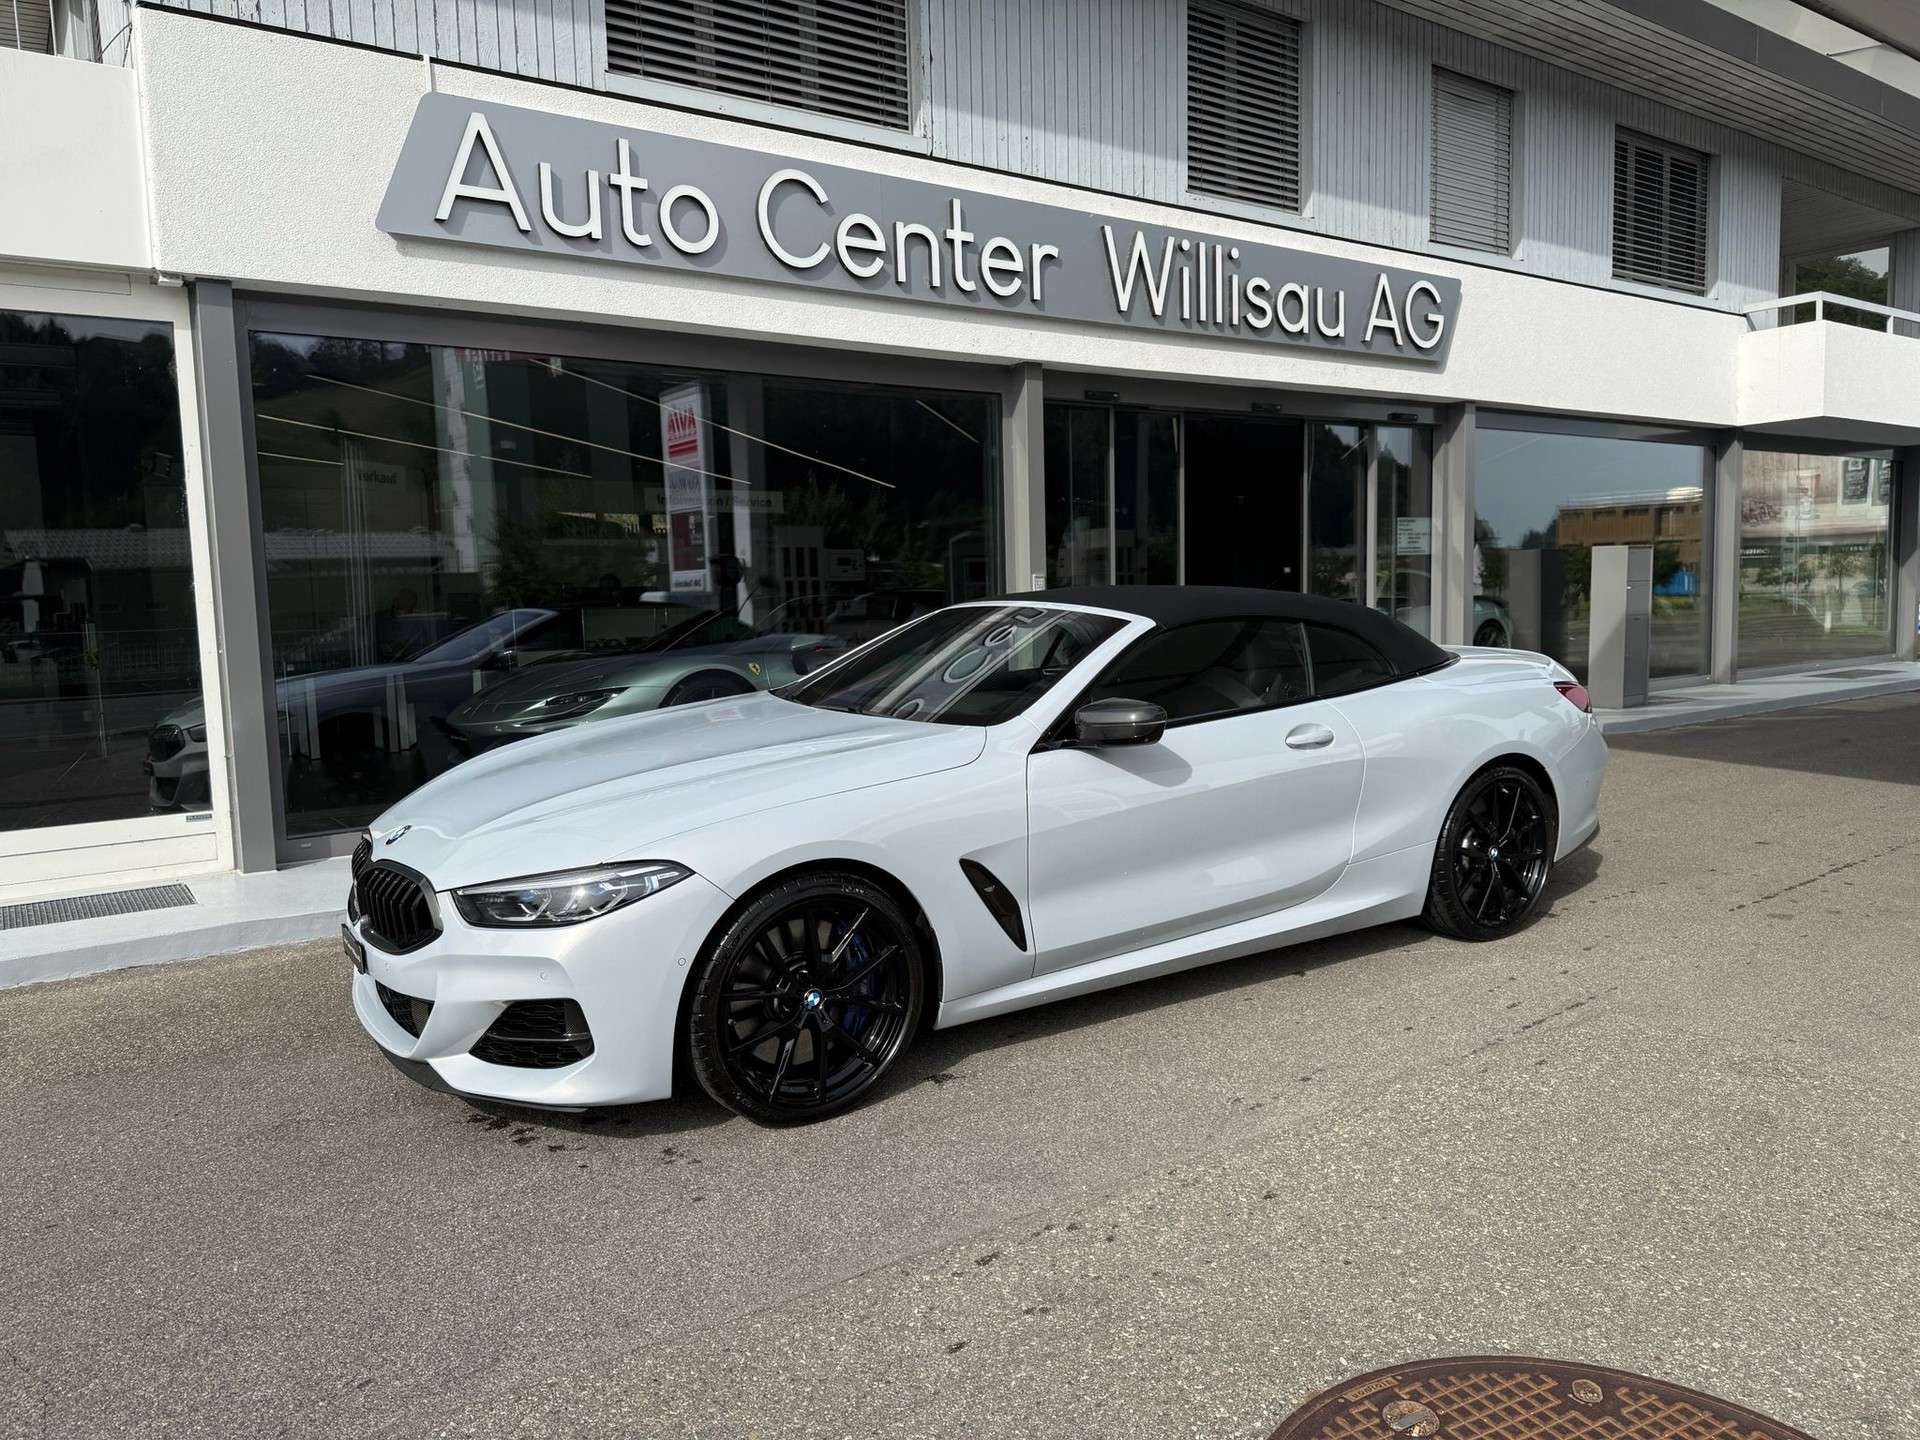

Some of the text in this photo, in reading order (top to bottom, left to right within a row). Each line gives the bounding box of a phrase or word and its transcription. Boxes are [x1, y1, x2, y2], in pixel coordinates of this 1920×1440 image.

[434, 111, 1445, 350] Auto Center Willisau AG
